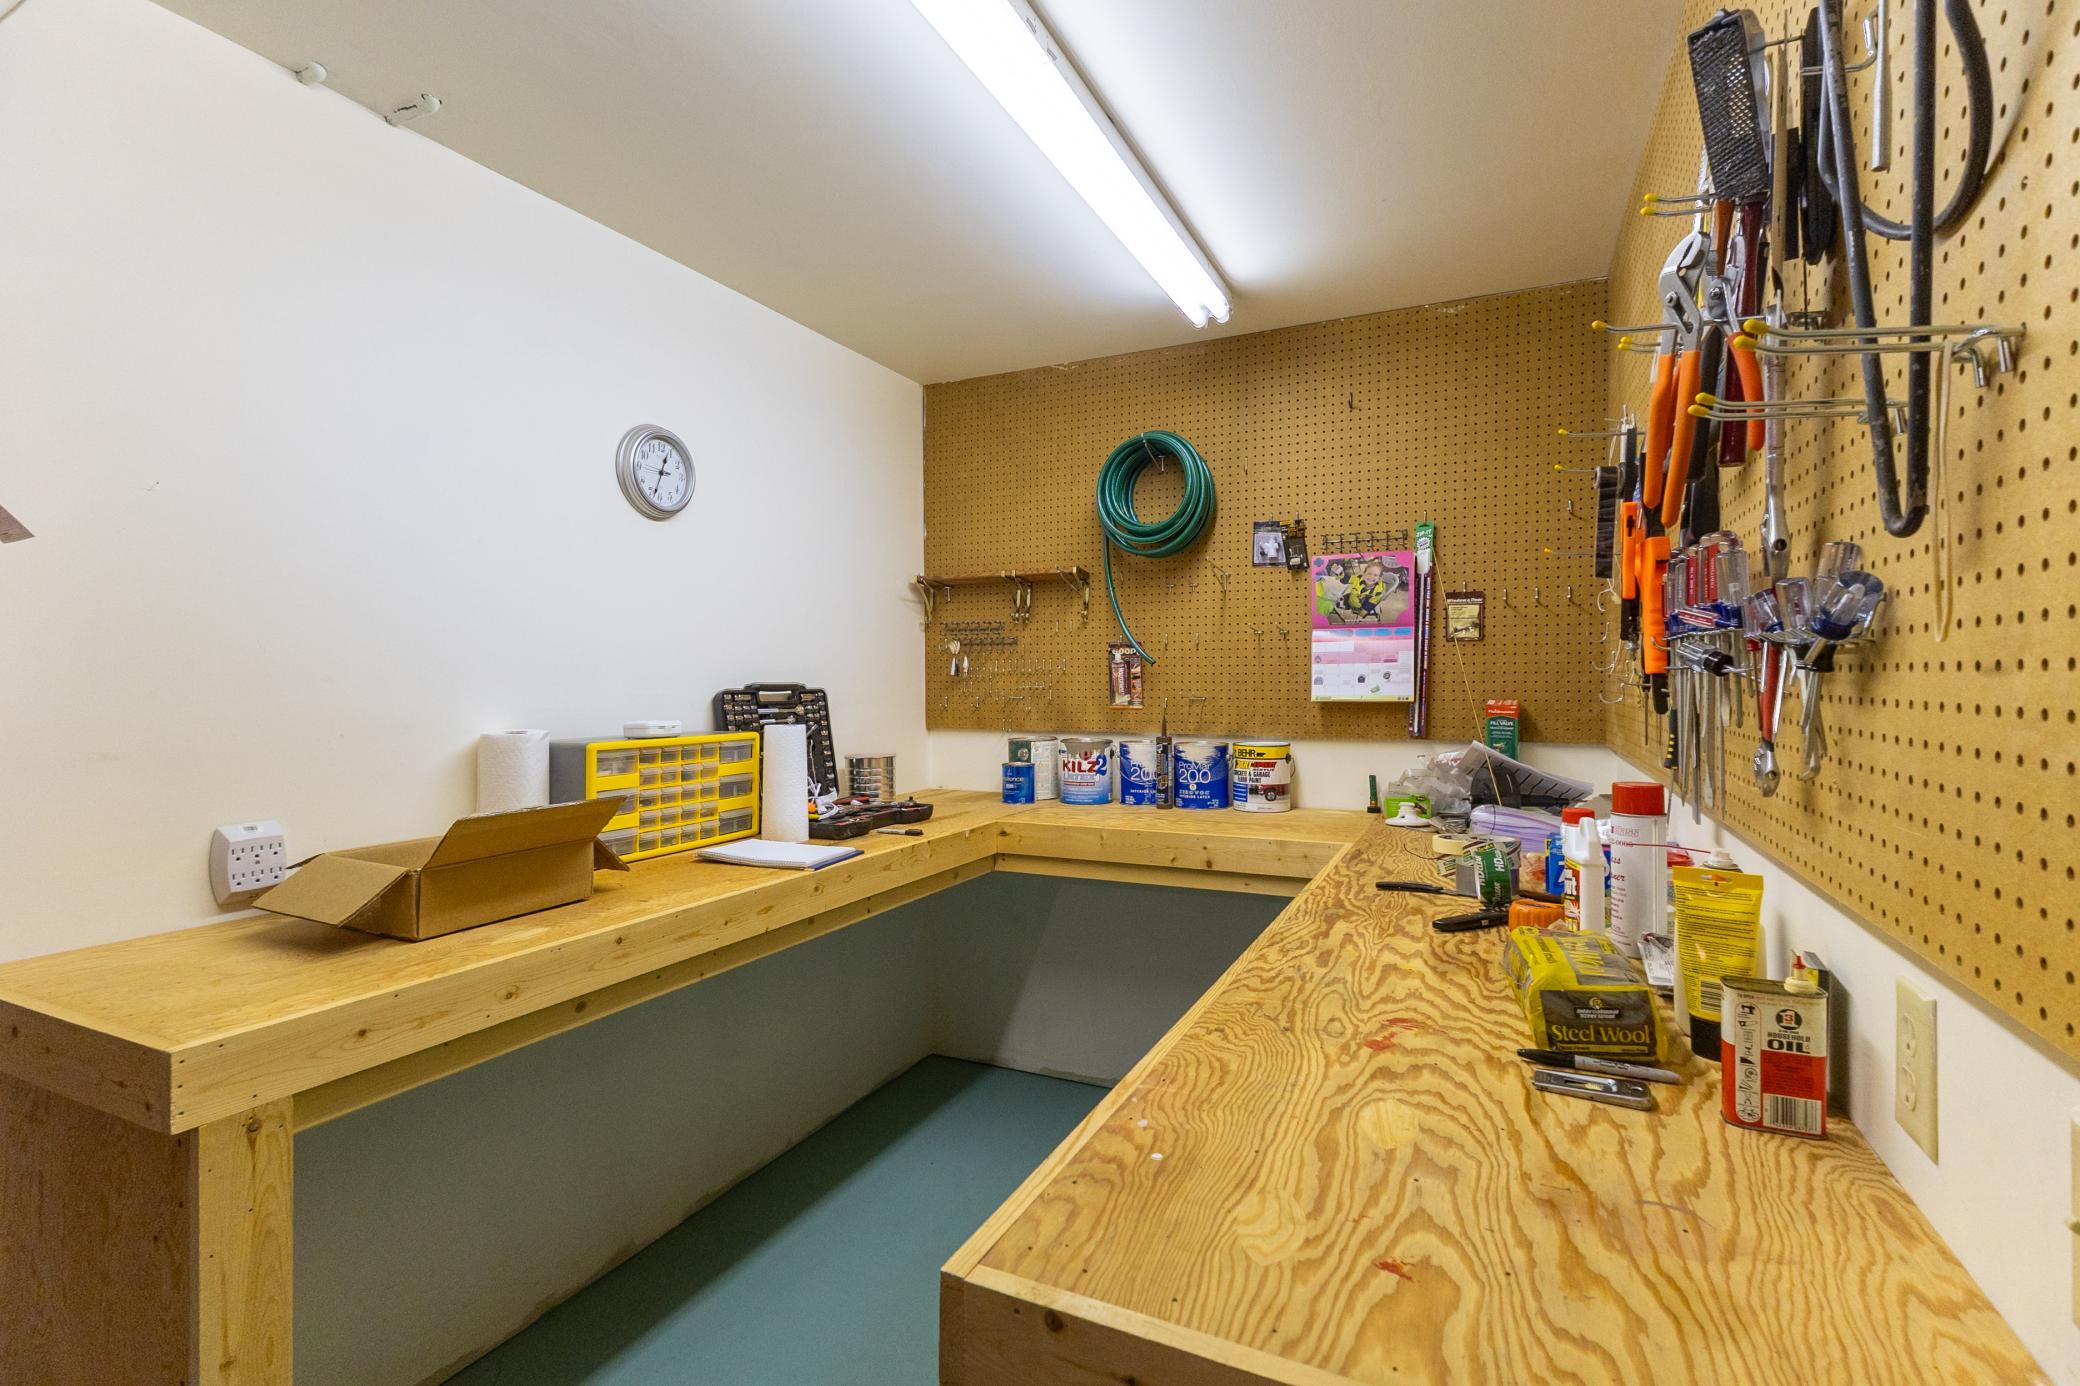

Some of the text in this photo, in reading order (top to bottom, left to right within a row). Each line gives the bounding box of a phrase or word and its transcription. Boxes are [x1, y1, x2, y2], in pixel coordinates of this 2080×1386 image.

[658, 442, 665, 452] 12
[1238, 749, 1256, 757] BEHR
[1062, 754, 1108, 776] KILZ 2
[1179, 769, 1211, 783] 200
[1551, 1024, 1651, 1043] Steel Wool
[1767, 1031, 1811, 1042] HOUSEHOLD
[1767, 1038, 1811, 1054] OIL
